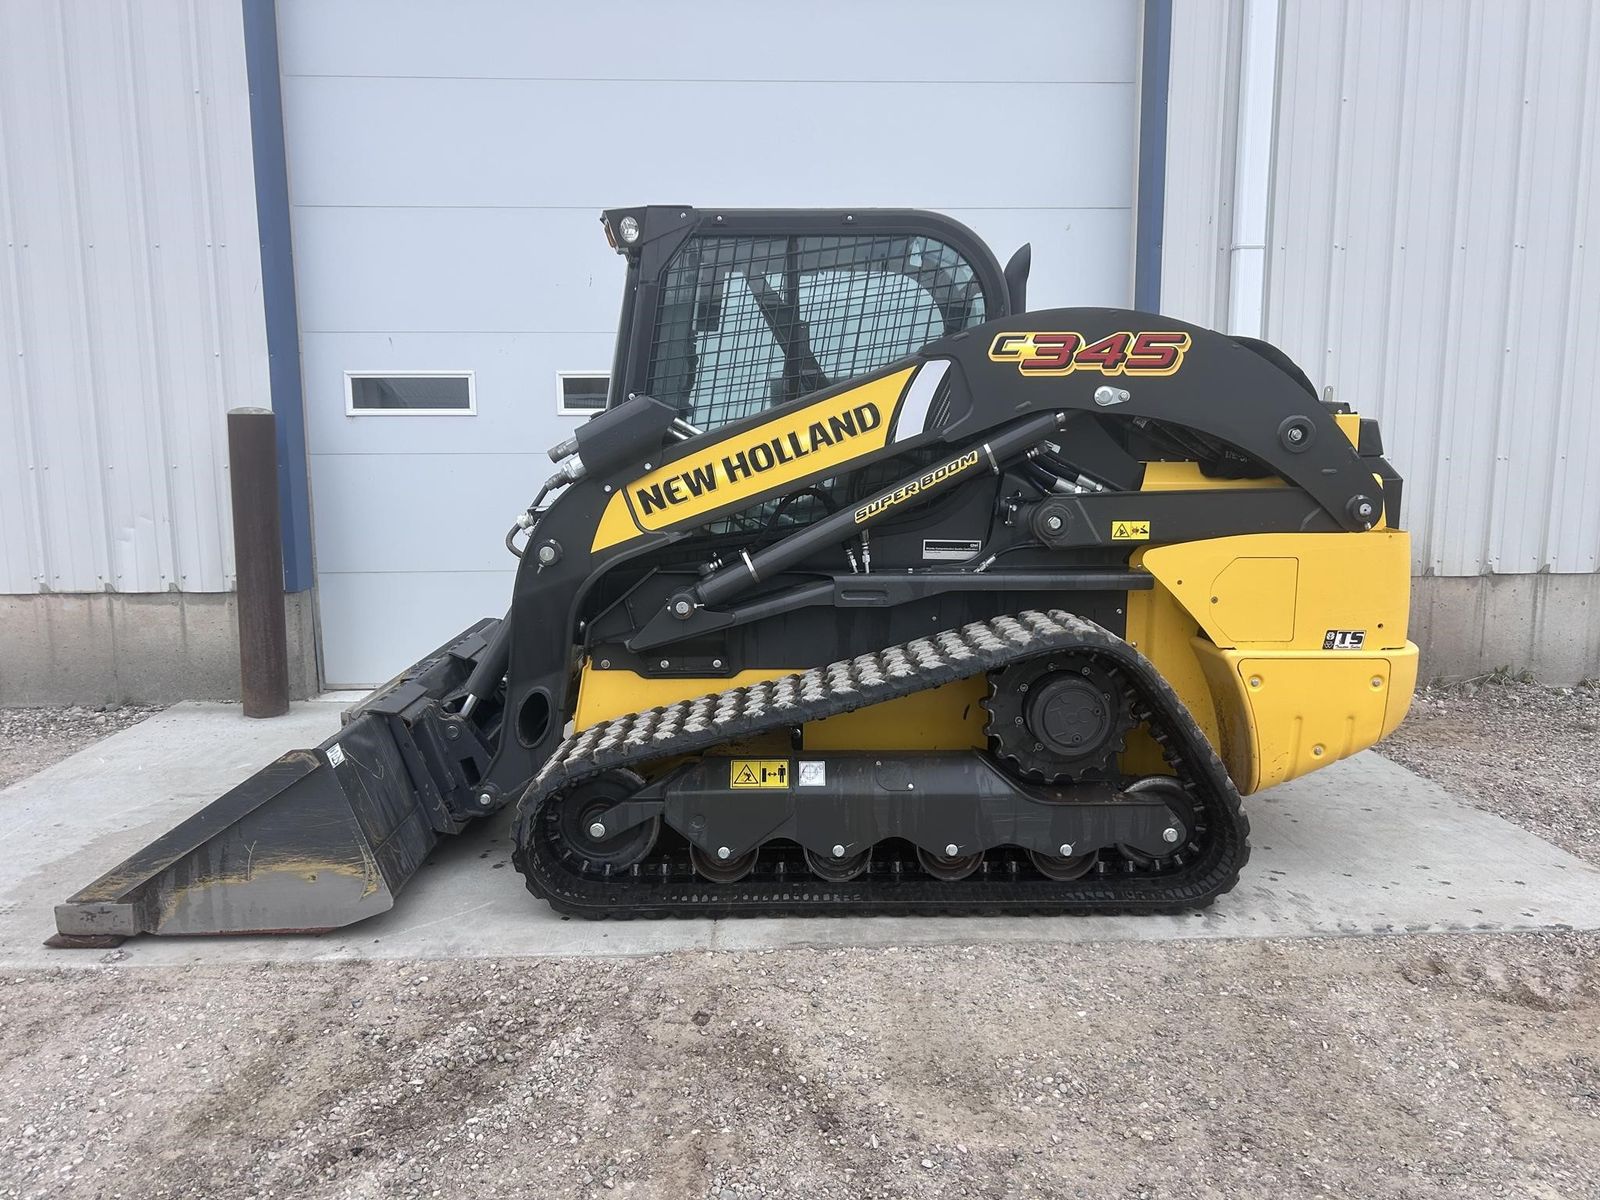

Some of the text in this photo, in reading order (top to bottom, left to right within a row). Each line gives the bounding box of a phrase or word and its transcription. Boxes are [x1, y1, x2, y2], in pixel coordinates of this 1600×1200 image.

[989, 332, 1190, 375] C345
[636, 402, 882, 516] NEW HOLLAND
[855, 450, 978, 523] SUPER BOOM
